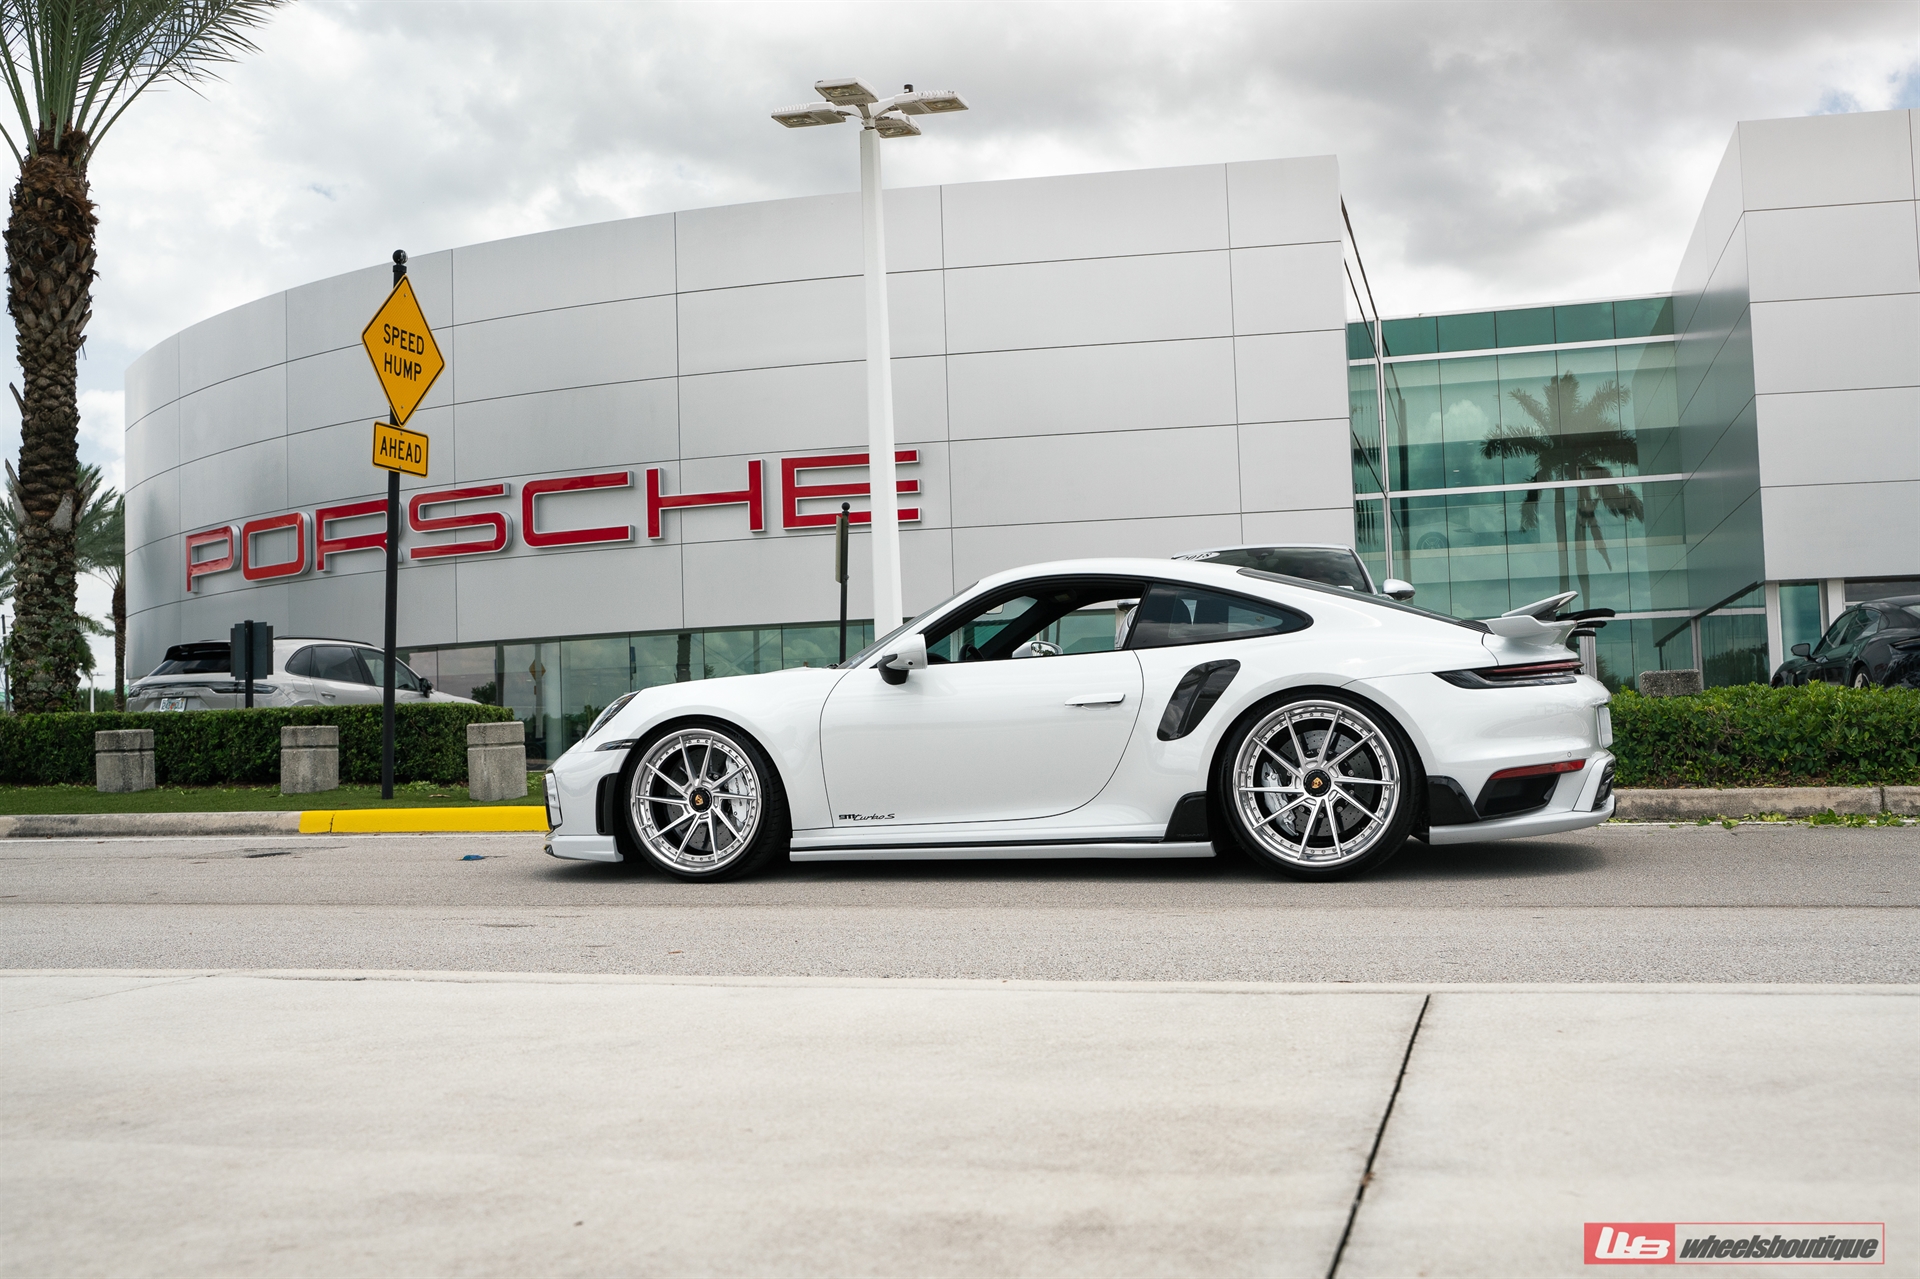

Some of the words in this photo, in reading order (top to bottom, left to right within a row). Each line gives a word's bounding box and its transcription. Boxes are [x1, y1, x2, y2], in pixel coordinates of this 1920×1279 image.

[383, 323, 424, 356] SPEED
[384, 352, 422, 381] HUMP
[379, 435, 422, 464] AHEAD
[186, 449, 921, 593] PORSCHE
